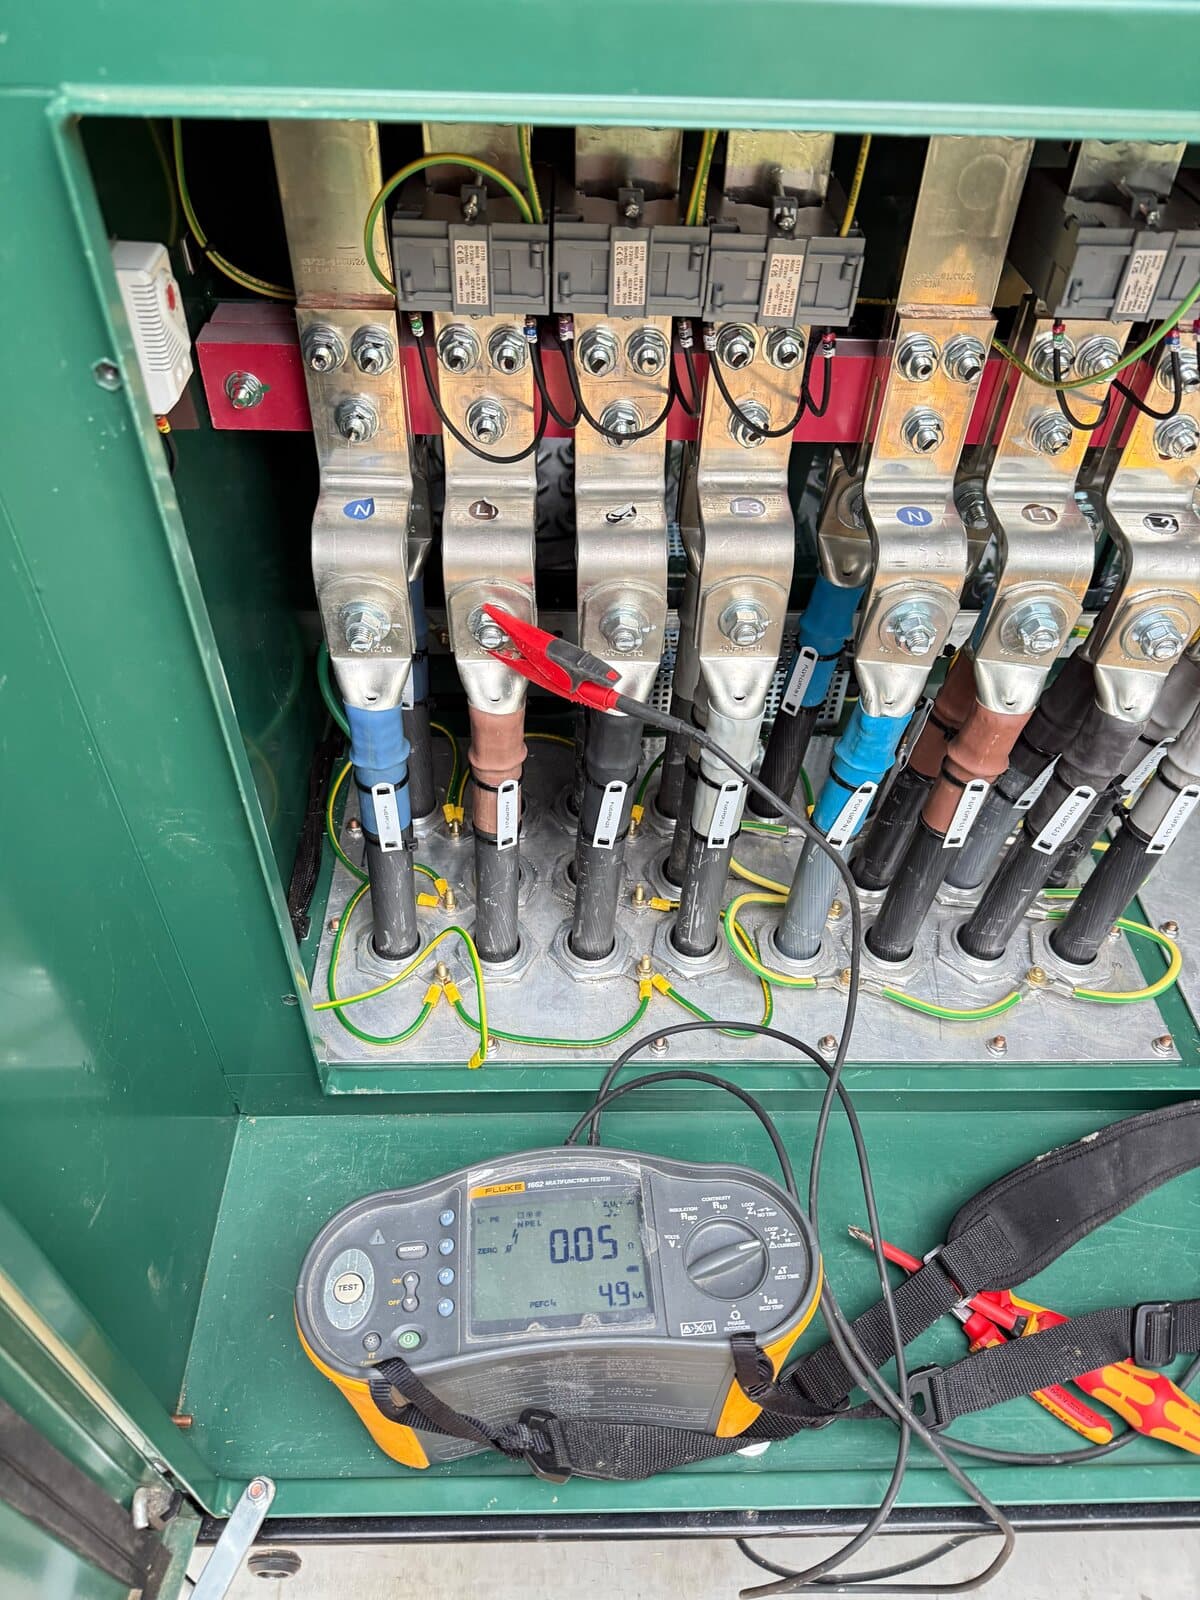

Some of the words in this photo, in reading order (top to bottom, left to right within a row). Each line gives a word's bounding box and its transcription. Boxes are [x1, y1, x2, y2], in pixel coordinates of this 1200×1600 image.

[354, 504, 371, 516] N
[735, 501, 761, 513] L3
[907, 511, 924, 522] N
[1028, 509, 1051, 520] L1
[484, 1183, 523, 1195] FLUKE
[545, 1177, 590, 1187] MULTIFUNCTION
[590, 1175, 611, 1183] TESTER
[550, 1224, 618, 1263] 0.05
[669, 1240, 676, 1248] V
[477, 1247, 497, 1255] ZERO
[338, 1284, 358, 1292] TEST
[599, 1281, 630, 1308] 4.9
[633, 1291, 645, 1299] kA
[529, 1301, 549, 1309] PEFC
